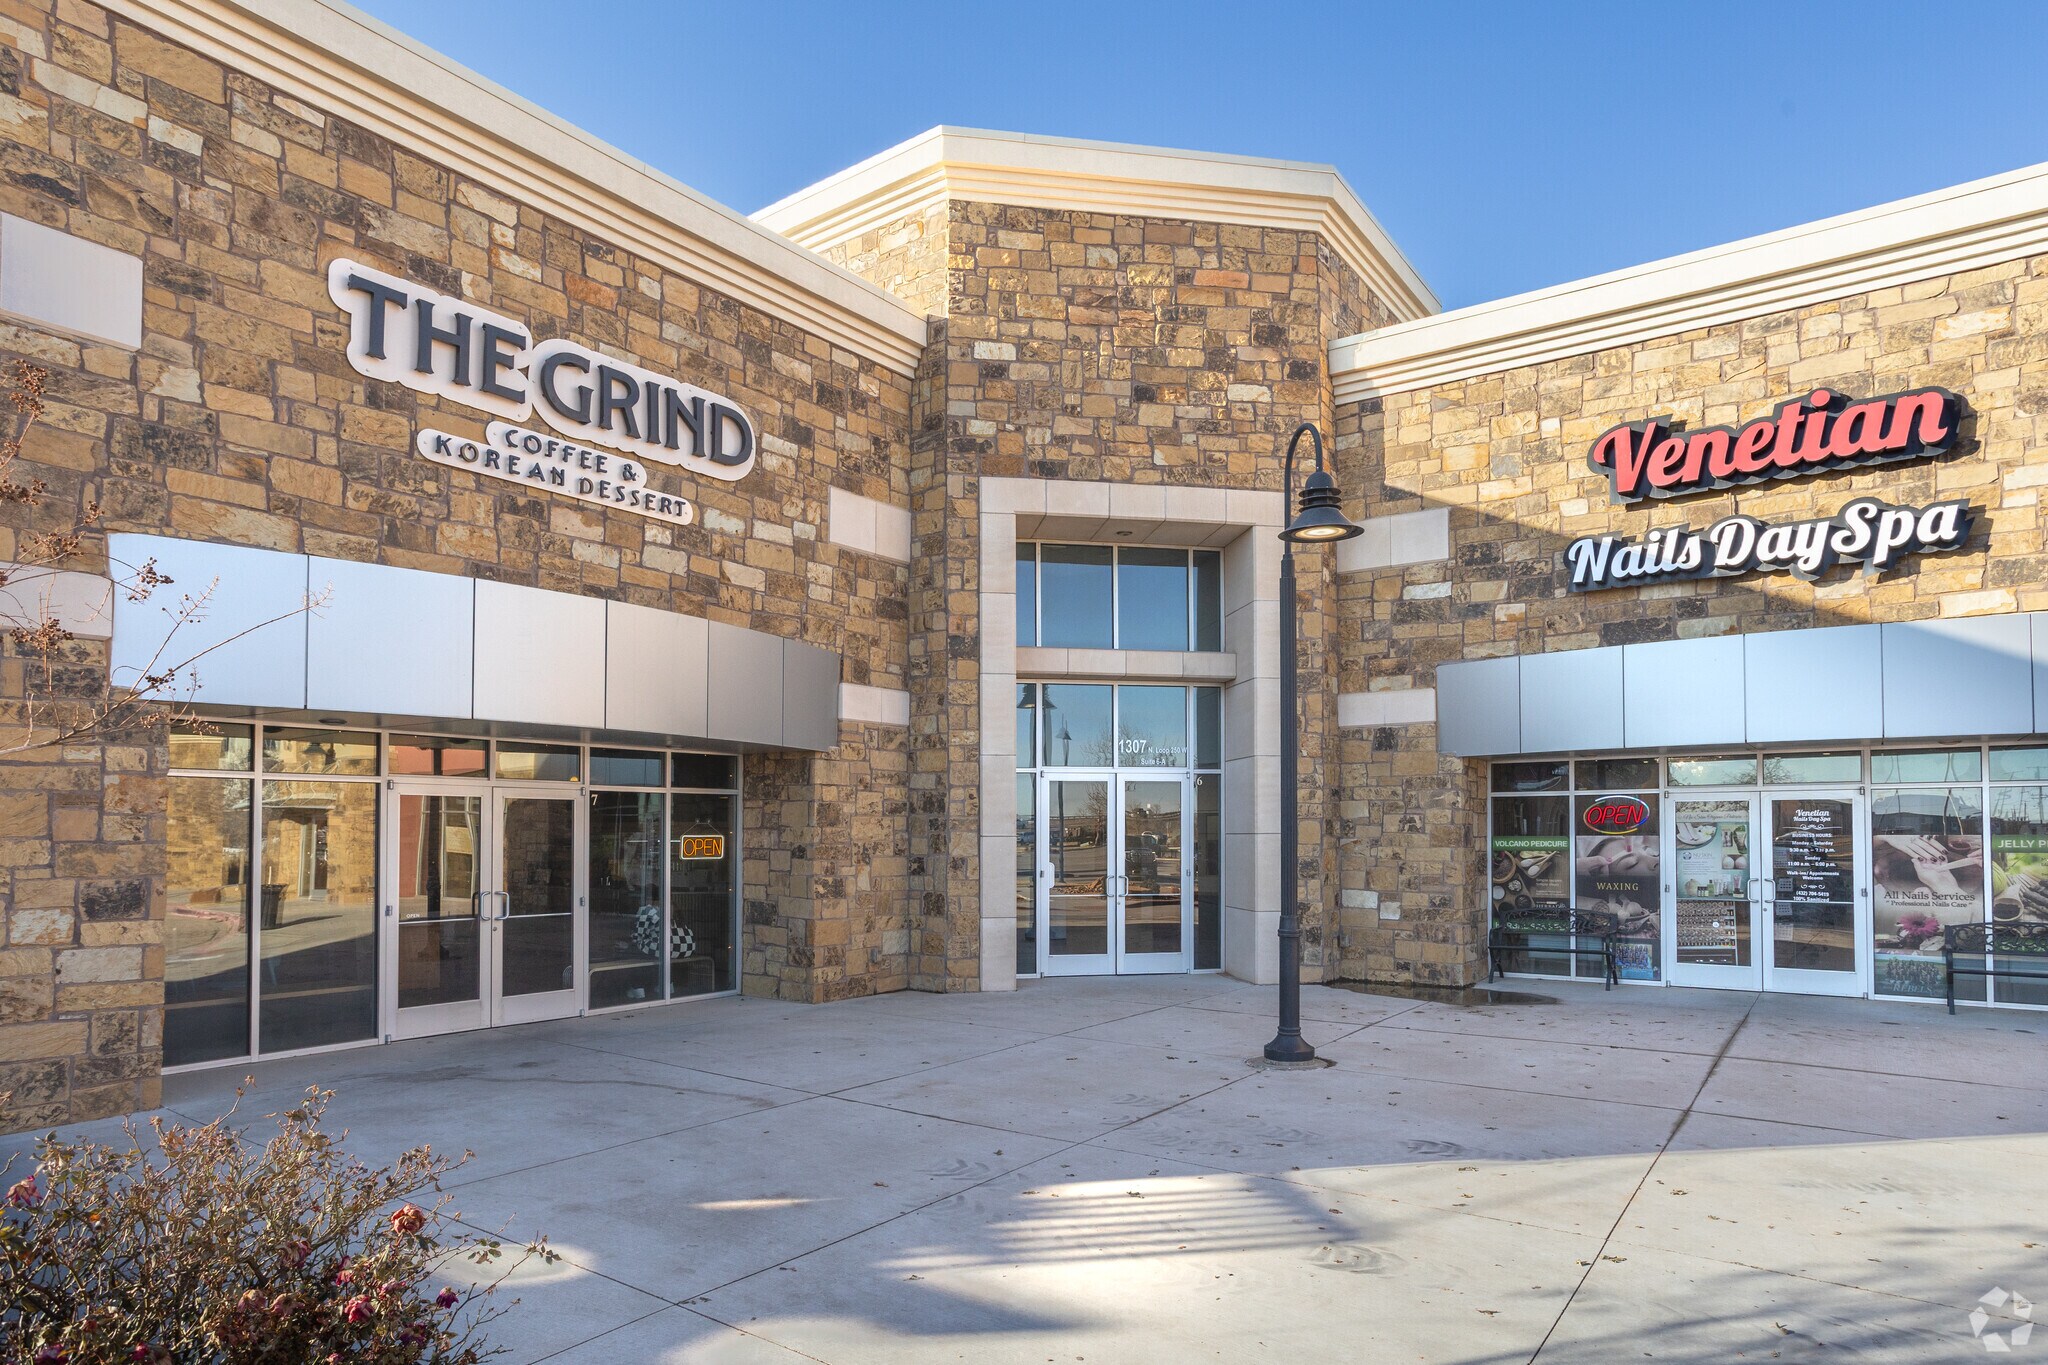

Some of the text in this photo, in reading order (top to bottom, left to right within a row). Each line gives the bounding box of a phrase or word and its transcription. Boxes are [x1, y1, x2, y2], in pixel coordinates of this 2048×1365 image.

[348, 274, 753, 467] THE GRIND
[1593, 389, 1948, 493] Venetian
[505, 429, 637, 482] COFFEE &
[435, 435, 686, 517] KOREAN DESSERT
[1567, 527, 1701, 583] Nails
[1118, 739, 1147, 754] 1307
[1155, 746, 1170, 755] Loop
[1140, 757, 1155, 765] Suite
[1196, 776, 1203, 786] 6
[591, 794, 599, 806] 7
[1587, 805, 1644, 825] OPEN
[683, 838, 722, 857] OPEN
[1998, 839, 2035, 848] JELLY
[1596, 882, 1639, 891] WAXING
[1883, 890, 1976, 902] All Nails Services
